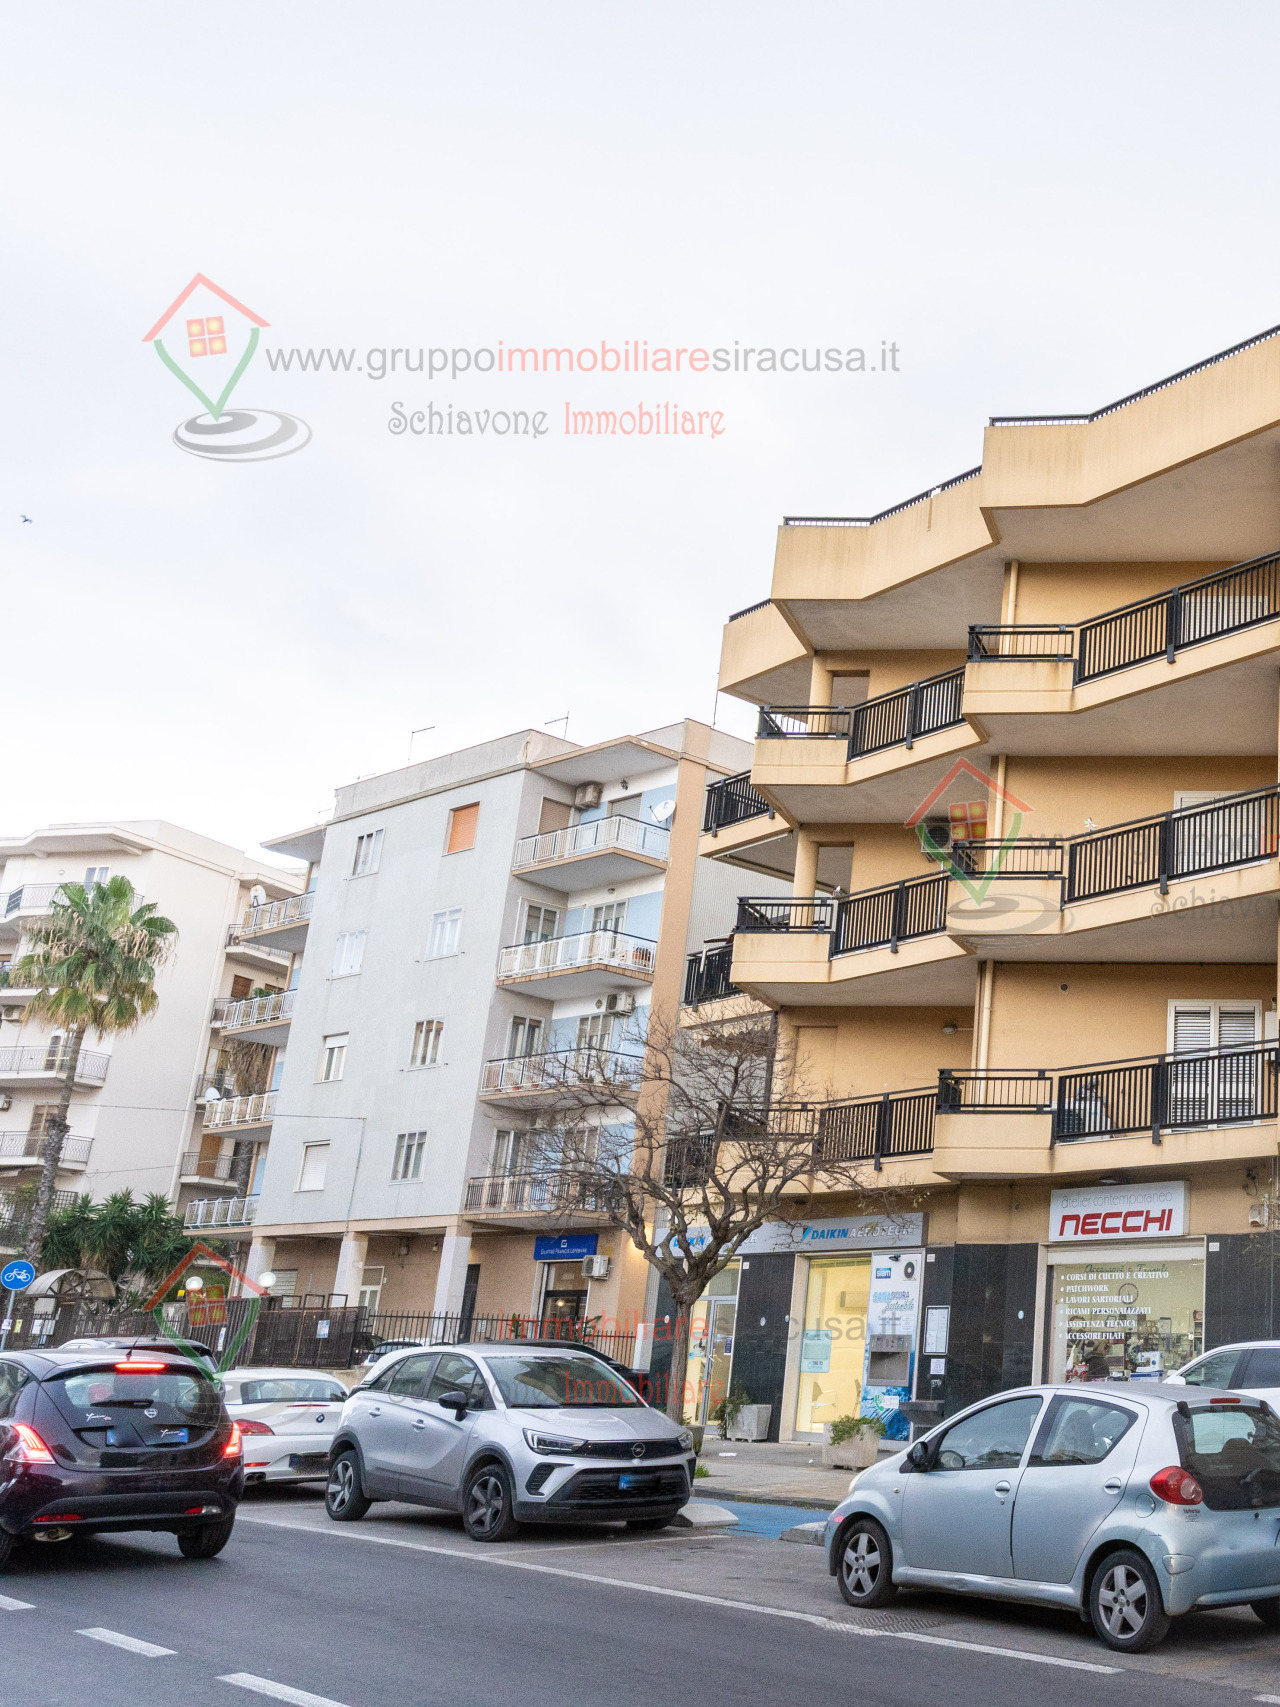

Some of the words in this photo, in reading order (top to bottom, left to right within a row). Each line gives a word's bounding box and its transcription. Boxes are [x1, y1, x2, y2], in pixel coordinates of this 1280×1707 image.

[1061, 1196, 1091, 1209] atelier
[1093, 1191, 1173, 1207] contemporaneo
[1059, 1209, 1173, 1236] NECCHI
[1066, 1273, 1087, 1281] CORSI
[1098, 1272, 1125, 1280] CUCITO
[1133, 1271, 1169, 1279] CREATIVO
[1066, 1284, 1109, 1292] PATCHWORK
[1065, 1295, 1090, 1304] LAVORI
[1092, 1295, 1134, 1303] SARTORIALI
[1065, 1307, 1090, 1315] RICAMI
[1092, 1306, 1152, 1315] PERSONALIZZATI
[1065, 1319, 1105, 1328] ASSISTENZA
[1106, 1319, 1137, 1328] TECNICA
[1064, 1332, 1101, 1340] ACCESSORI
[1102, 1332, 1125, 1340] FILATI
